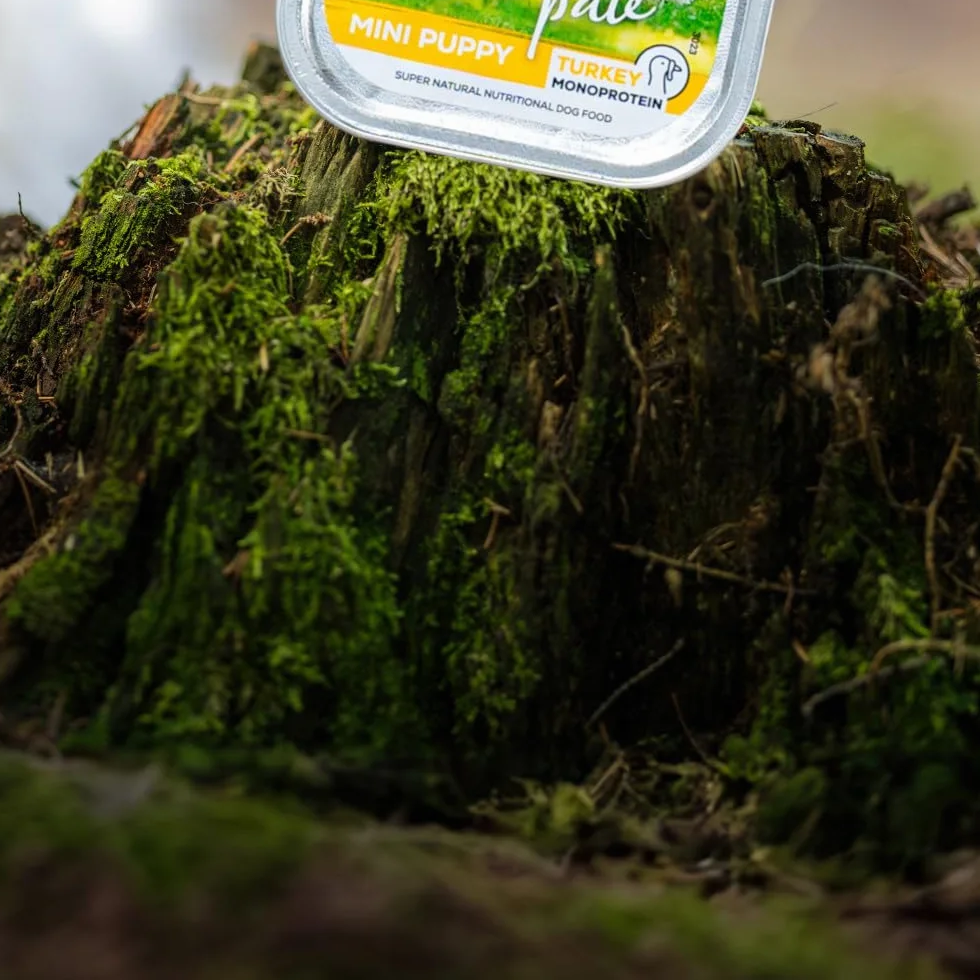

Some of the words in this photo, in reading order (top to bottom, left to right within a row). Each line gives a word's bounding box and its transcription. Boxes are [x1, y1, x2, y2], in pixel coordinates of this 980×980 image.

[348, 13, 412, 45] MINI
[418, 27, 514, 65] PUPPY
[558, 55, 642, 86] TURKEY
[395, 70, 430, 86] SUPER
[432, 78, 482, 97] NATURAL
[483, 90, 553, 112] NUTRITIONAL
[556, 104, 579, 117] DOG
[581, 109, 613, 123] FOOD
[552, 77, 663, 109] MONOPROTEIN
